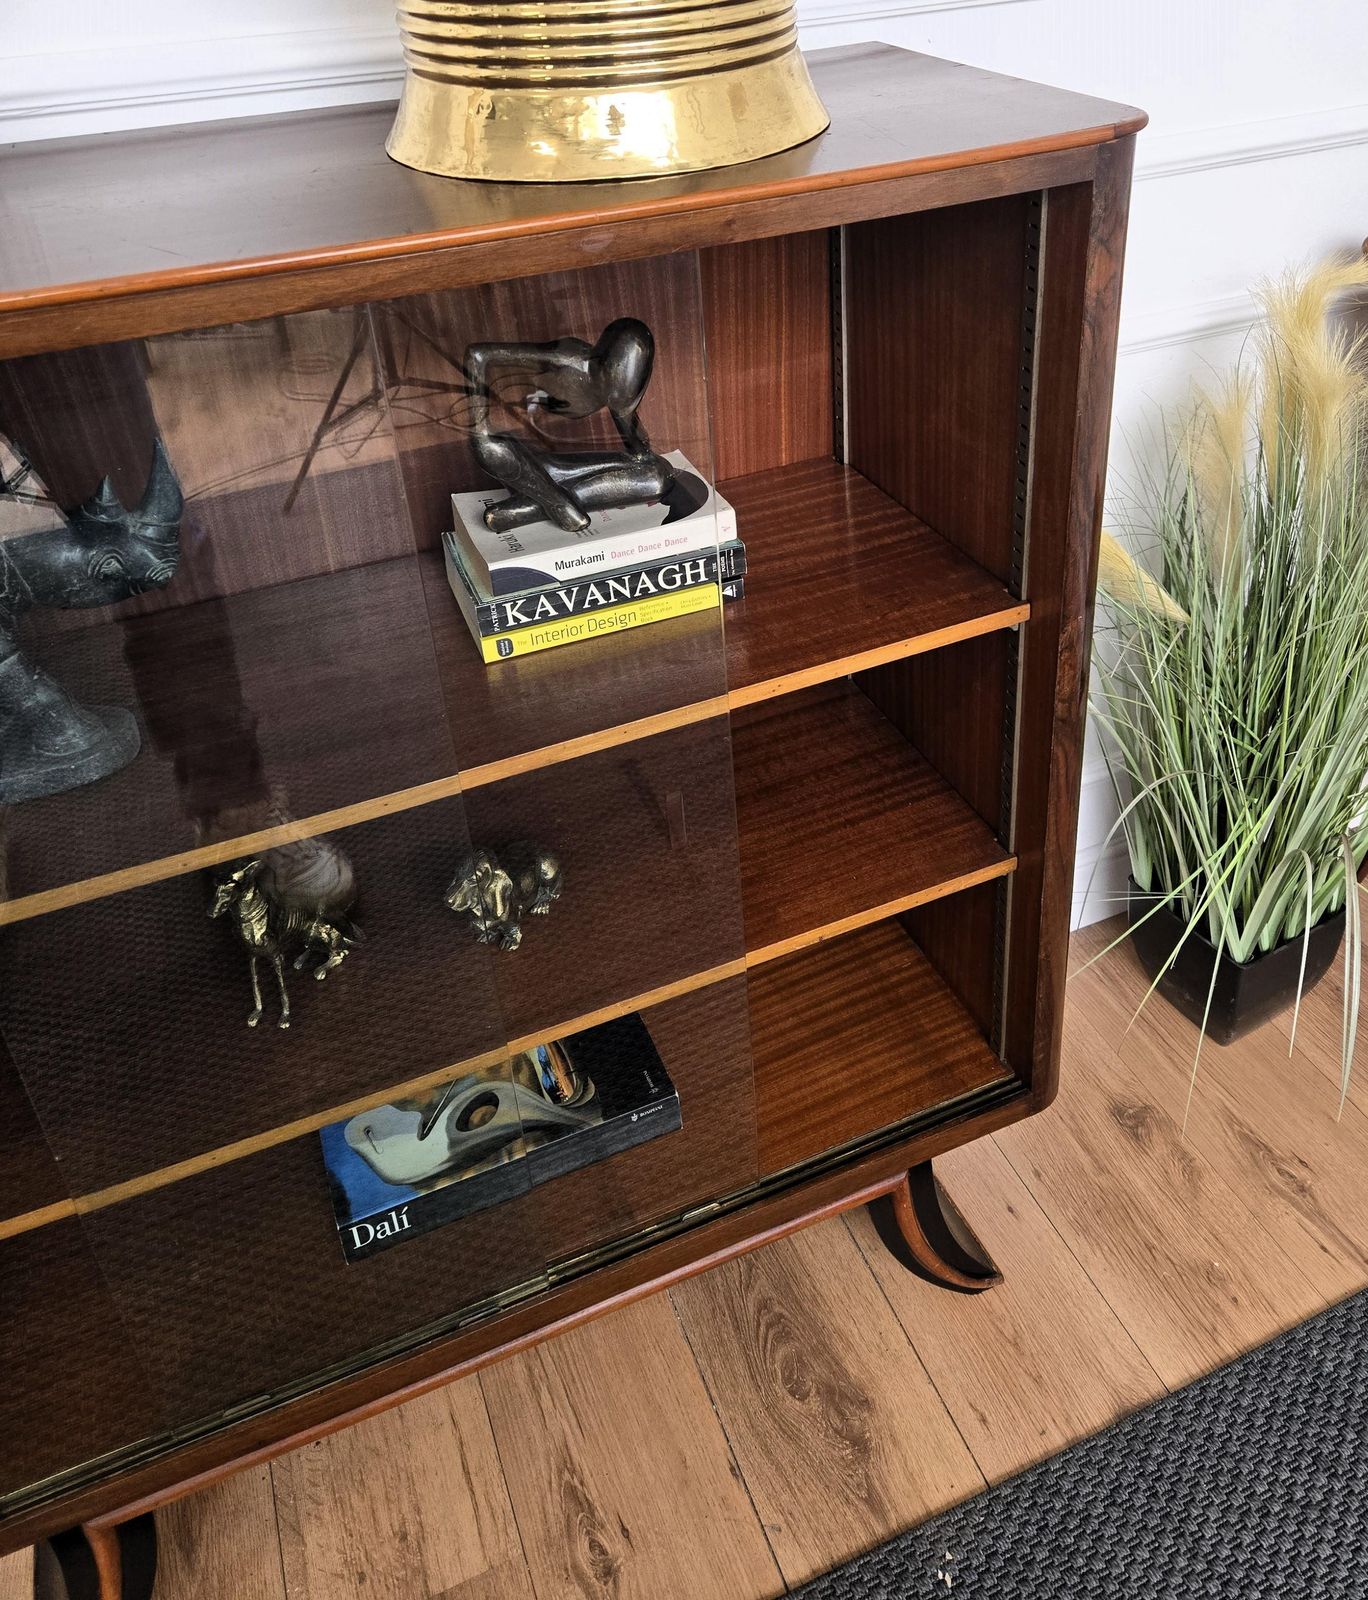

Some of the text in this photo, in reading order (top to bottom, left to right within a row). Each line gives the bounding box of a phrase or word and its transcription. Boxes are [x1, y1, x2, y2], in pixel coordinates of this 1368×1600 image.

[555, 535, 689, 571] Murakami Dance Dance Dance
[490, 602, 500, 632] PATRICK
[502, 558, 709, 627] KAVANAGH
[530, 624, 584, 646] Interior
[587, 610, 637, 634] Design
[348, 1206, 412, 1250] Dalí
